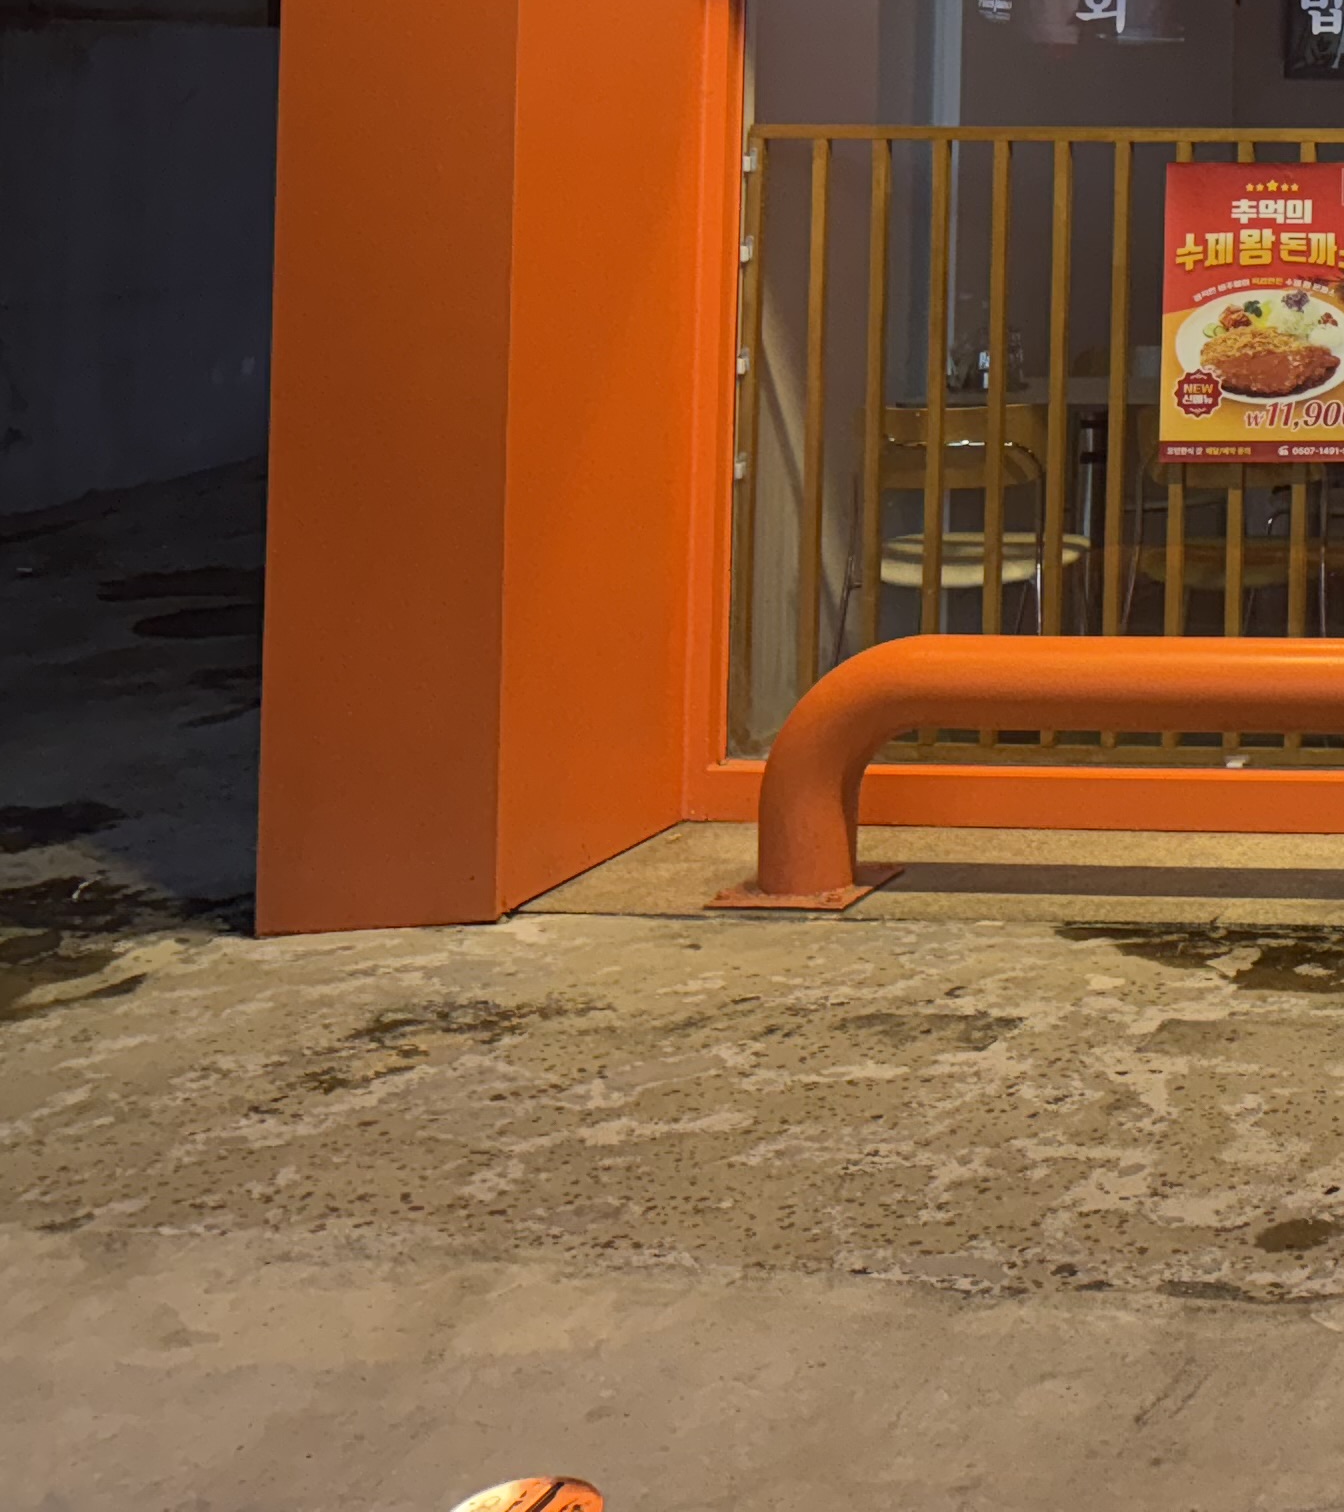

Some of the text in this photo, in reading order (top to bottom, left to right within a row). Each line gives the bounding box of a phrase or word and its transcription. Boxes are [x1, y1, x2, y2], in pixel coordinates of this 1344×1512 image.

[1231, 199, 1313, 224] 추억의
[1176, 231, 1234, 271] 수제
[1239, 228, 1276, 266] 왕
[1183, 383, 1214, 395] NEW
